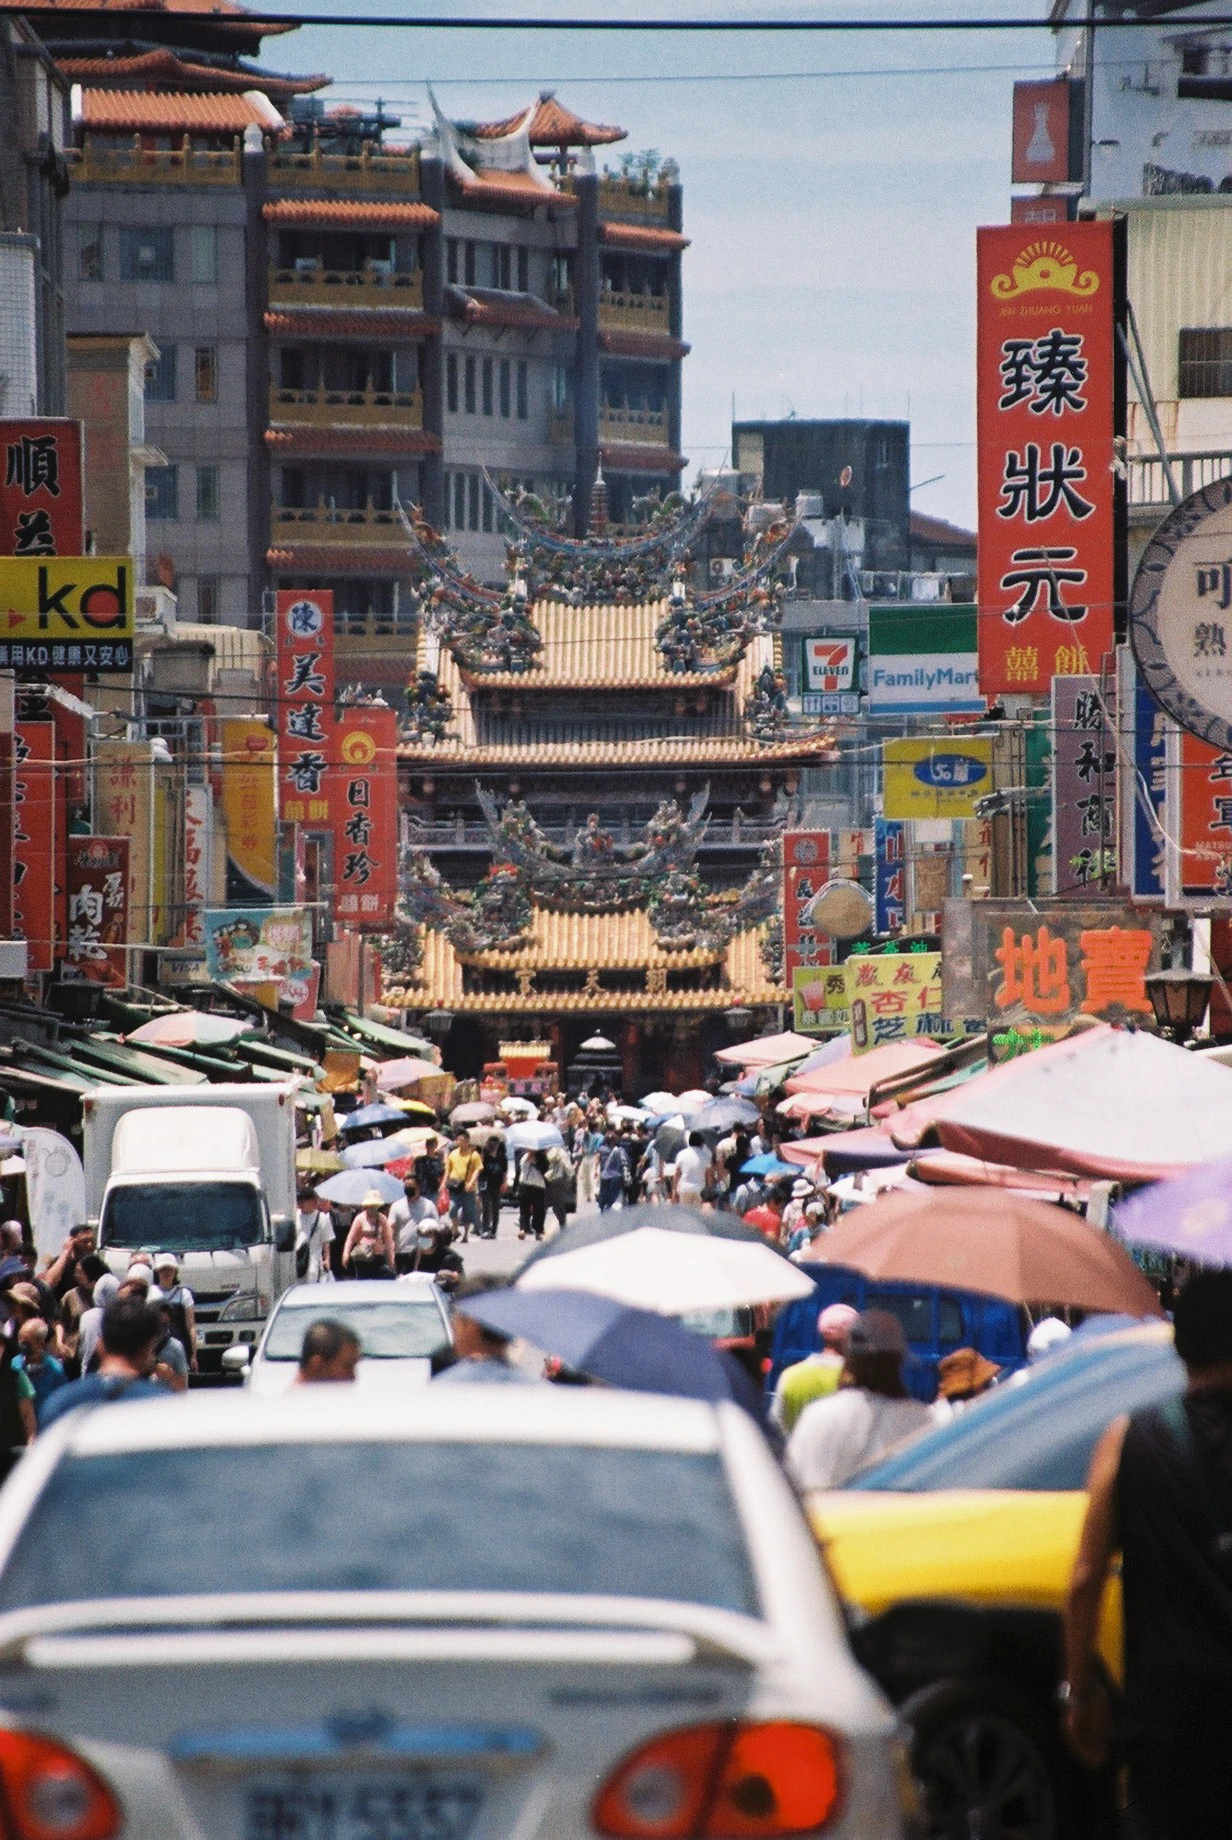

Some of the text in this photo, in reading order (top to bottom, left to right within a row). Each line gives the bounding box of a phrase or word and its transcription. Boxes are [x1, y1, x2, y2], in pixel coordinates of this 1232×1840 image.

[996, 328, 1096, 623] 臻狀元
[38, 566, 127, 630] kd
[343, 777, 380, 886] 日香珍
